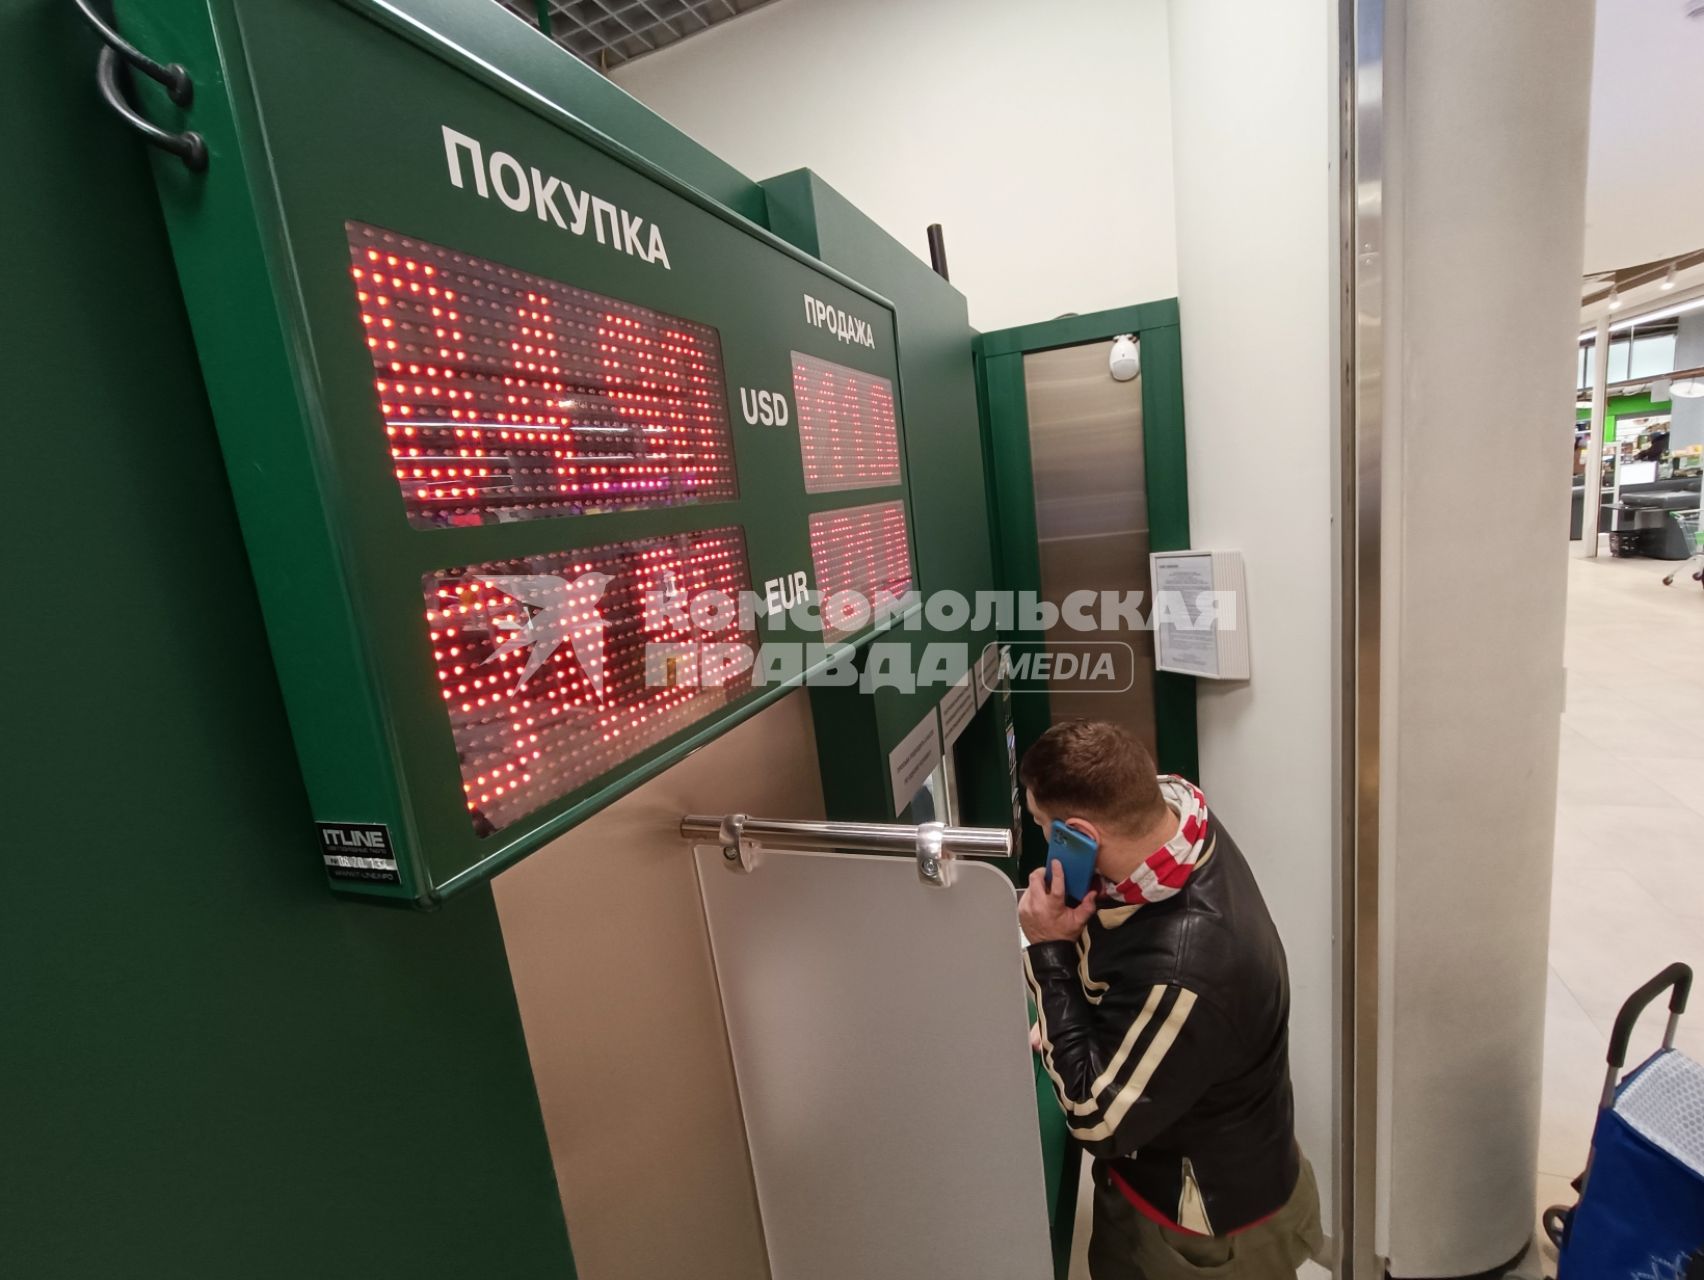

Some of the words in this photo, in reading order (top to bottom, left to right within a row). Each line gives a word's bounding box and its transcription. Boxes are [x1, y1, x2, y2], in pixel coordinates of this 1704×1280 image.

[441, 125, 671, 270] ПОКУПКА
[804, 294, 875, 350] ПРОДАЖА
[740, 387, 789, 428] USD
[765, 571, 809, 616] EUR
